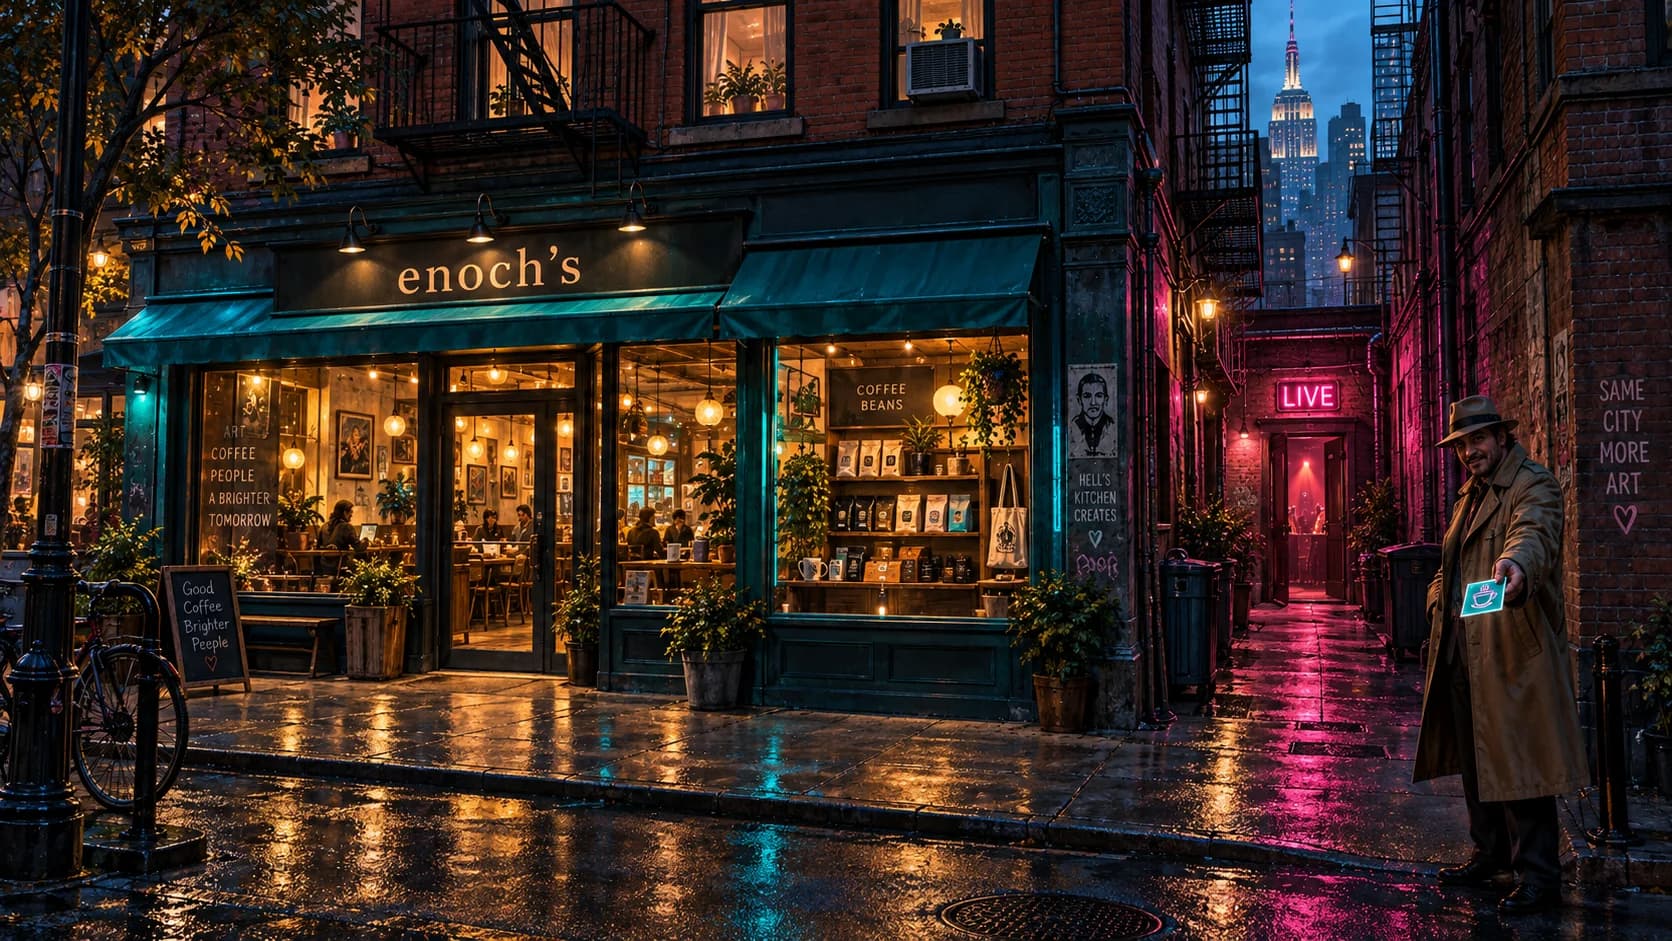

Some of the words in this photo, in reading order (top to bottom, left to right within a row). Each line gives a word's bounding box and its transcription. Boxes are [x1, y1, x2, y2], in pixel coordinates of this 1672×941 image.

[398, 245, 581, 294] enoch's
[856, 383, 907, 396] COFFEE
[1283, 386, 1334, 407] LIVE
[1599, 379, 1645, 401] SAME
[861, 399, 904, 411] BEANS
[1603, 409, 1642, 432] CITY
[223, 425, 246, 439] ART
[211, 446, 256, 460] COFFEE
[1600, 441, 1650, 464] MORE
[210, 469, 255, 482] PEOPLE
[1079, 473, 1111, 487] HELL'S
[1606, 472, 1641, 494] ART
[208, 492, 216, 505] A
[219, 492, 271, 505] BRIGHTER
[1074, 491, 1117, 505] KITCHEN
[208, 513, 272, 527] TOMORROW
[1074, 509, 1117, 522] CREATES
[182, 579, 215, 596] Good
[183, 599, 223, 616] Coffee
[184, 618, 230, 636] Brighter
